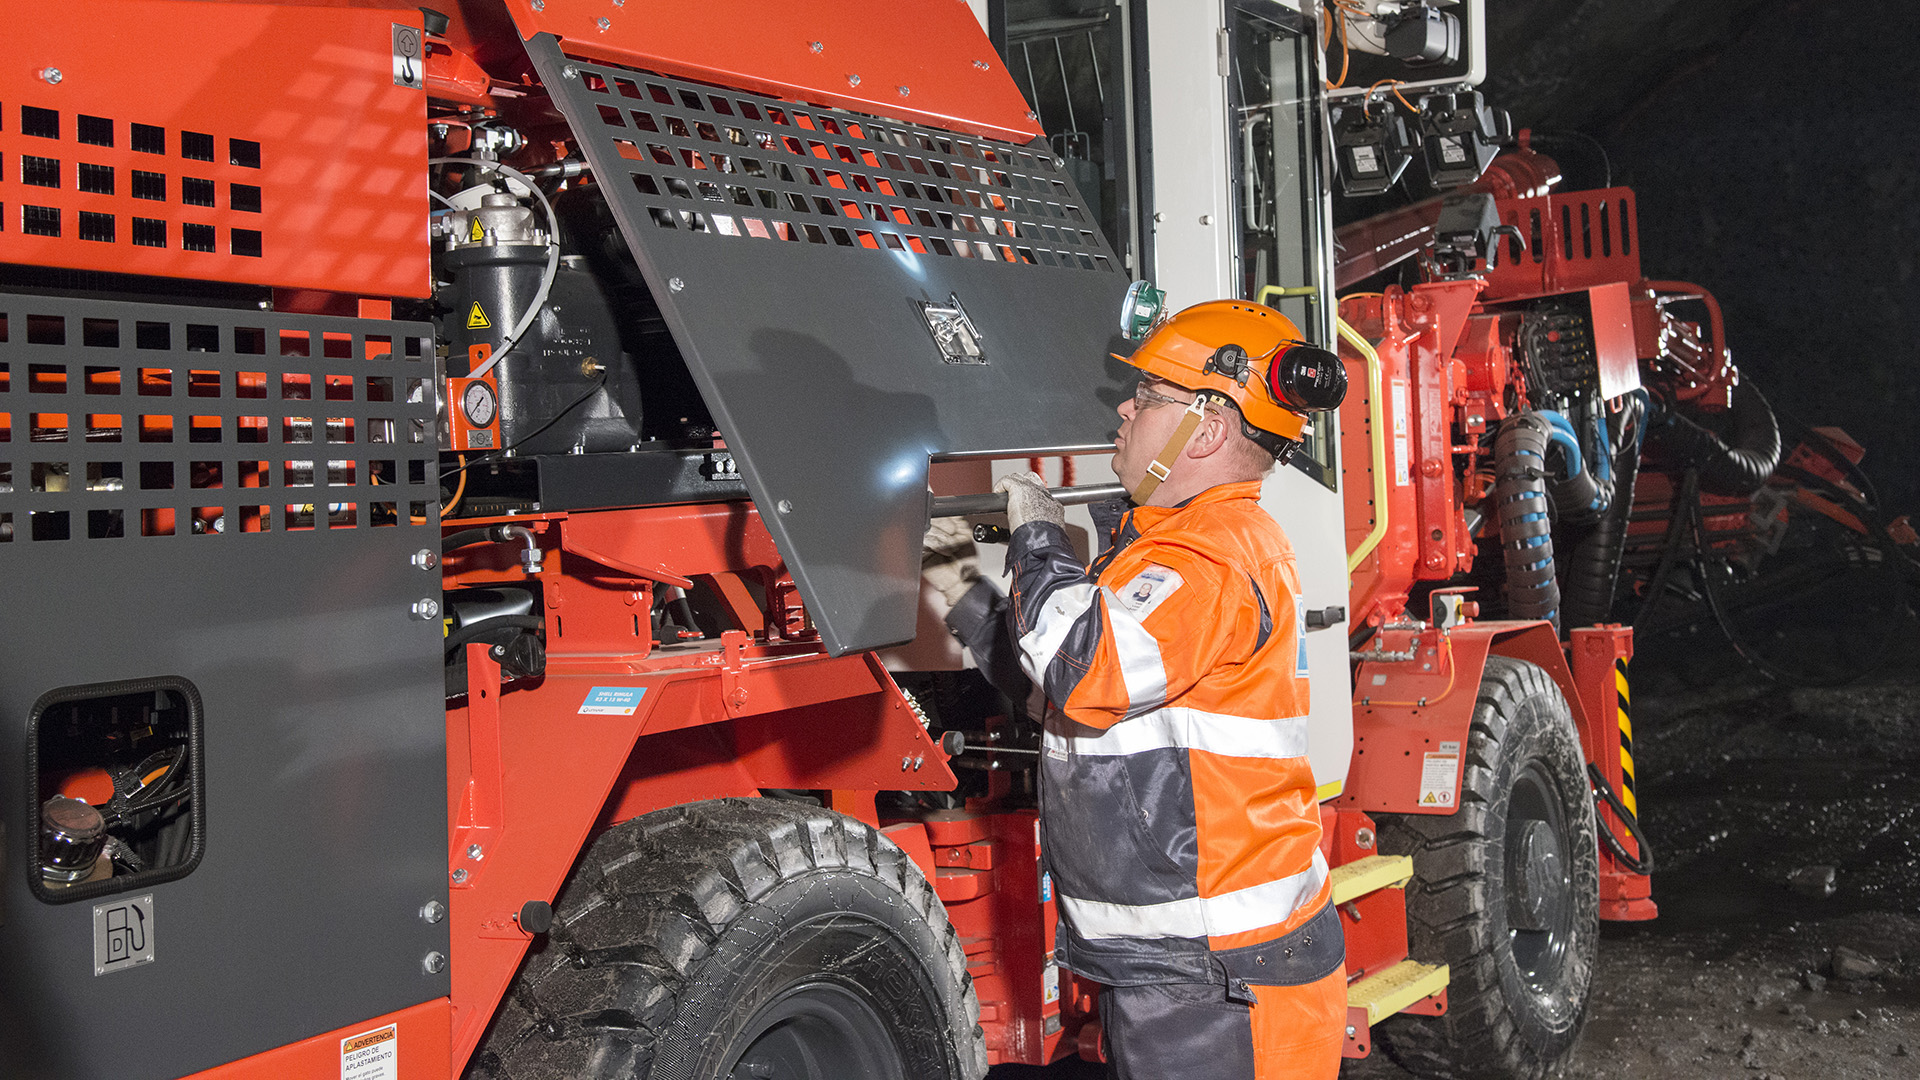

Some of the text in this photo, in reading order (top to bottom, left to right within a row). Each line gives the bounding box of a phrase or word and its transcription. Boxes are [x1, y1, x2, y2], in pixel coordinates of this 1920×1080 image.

[113, 937, 123, 952] D
[354, 1032, 393, 1048] ADVERTENCIA
[346, 1046, 379, 1062] PELIGRO DE
[346, 1051, 392, 1071] APLASTAMIENTO
